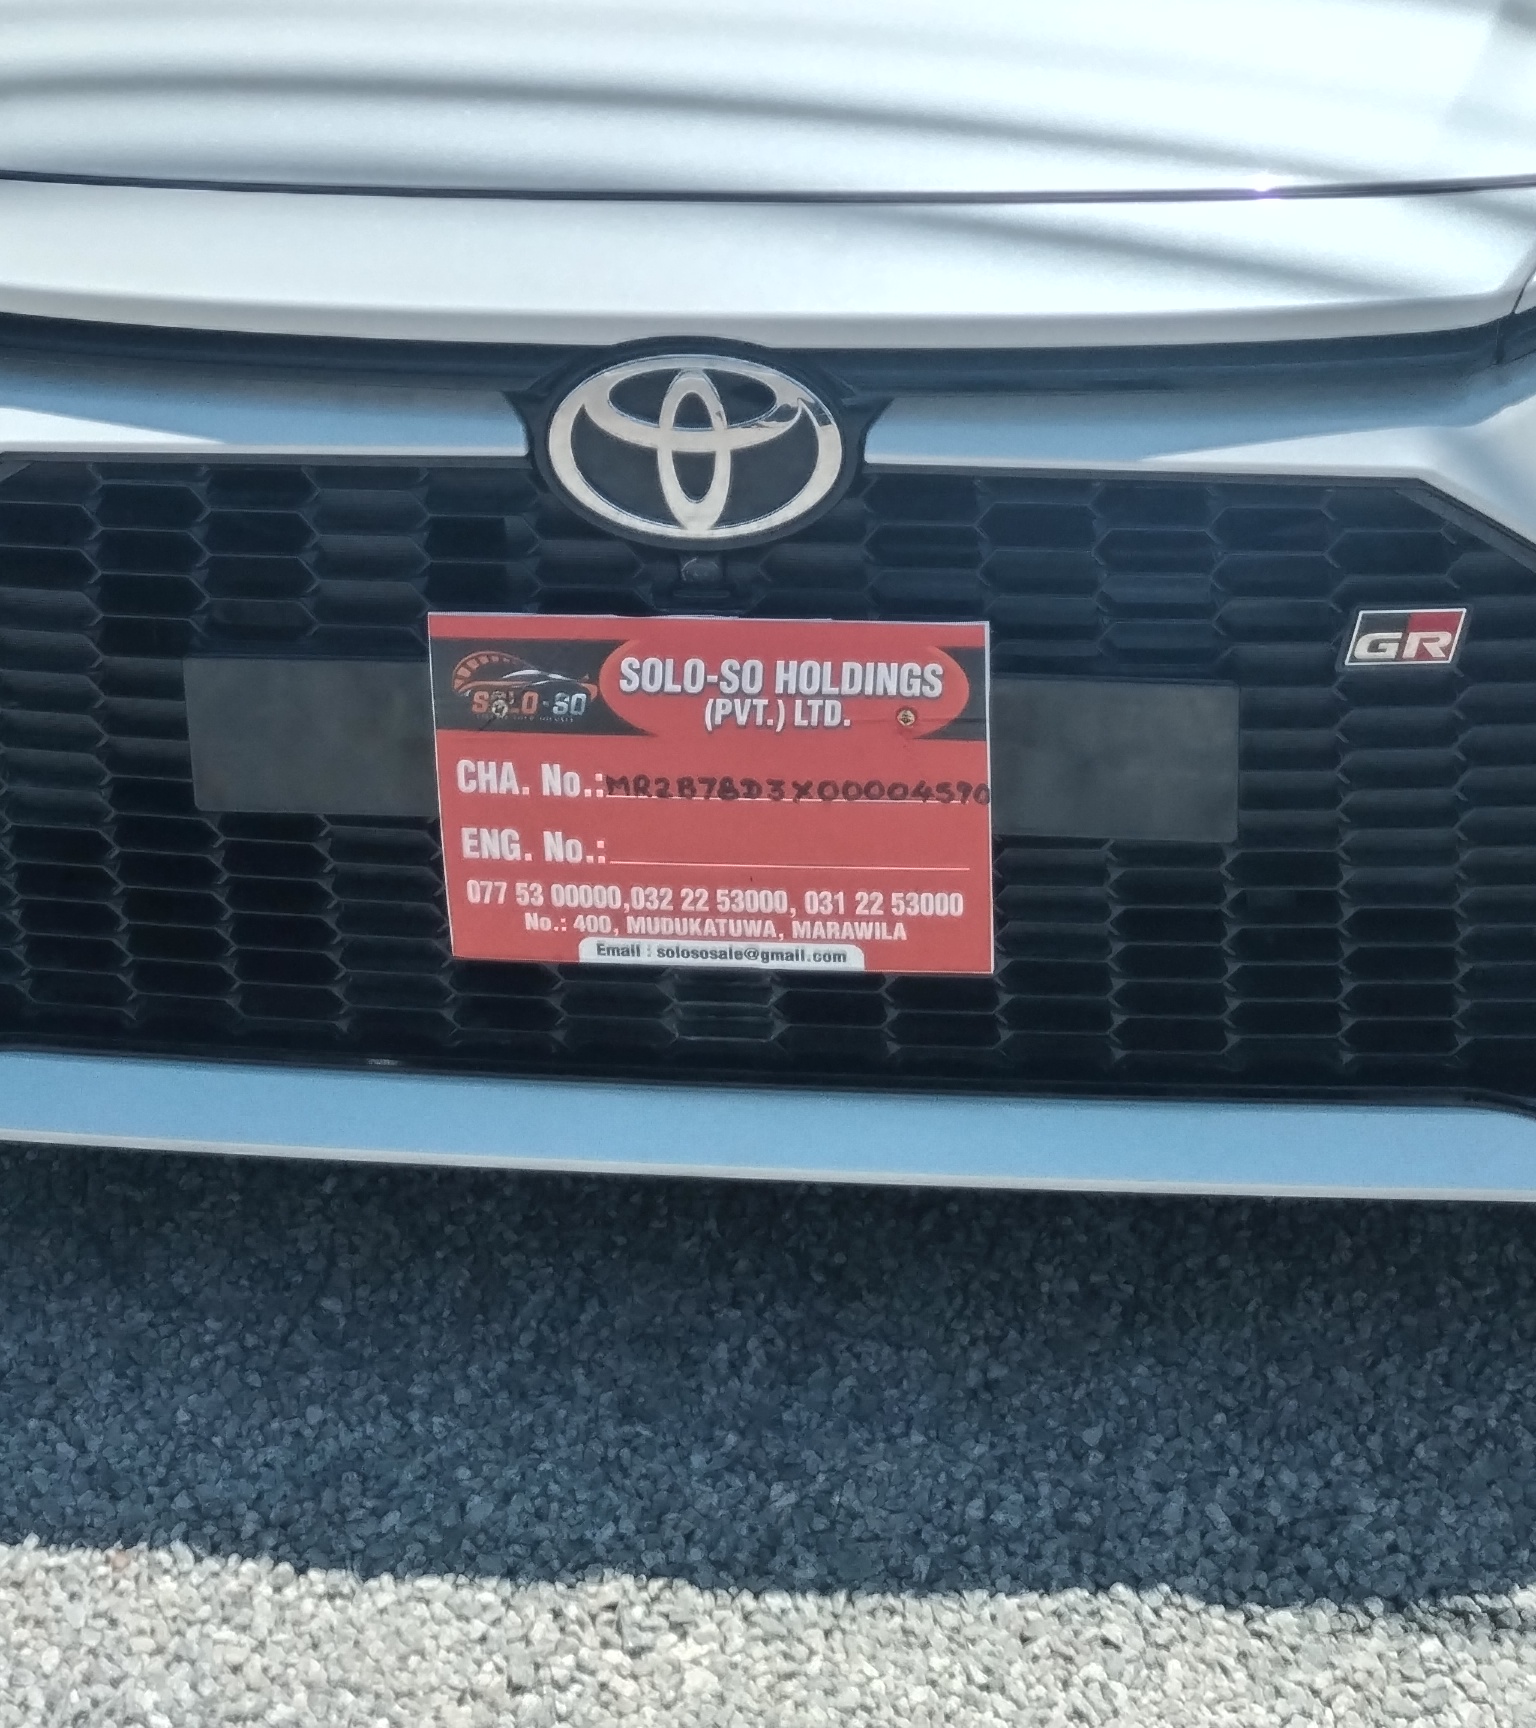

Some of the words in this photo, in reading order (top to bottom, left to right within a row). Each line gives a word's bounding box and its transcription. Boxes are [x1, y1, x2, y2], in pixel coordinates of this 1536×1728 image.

[1354, 631, 1452, 659] GR
[619, 656, 763, 695] SOLO-SO
[774, 659, 944, 699] HOLDINGS
[704, 697, 786, 733] (PVT.)
[794, 698, 851, 729] LTD.
[457, 759, 530, 795] CHA.
[541, 762, 604, 798] No.:
[461, 828, 533, 862] ENG.
[544, 830, 606, 865] No.:
[467, 879, 507, 905] 077
[515, 882, 544, 907] 53
[680, 887, 710, 912] 22
[716, 888, 797, 918] 53000,
[804, 890, 845, 915] 031
[855, 891, 884, 916] 22
[891, 892, 963, 917] 53000
[573, 914, 620, 937] 400,
[626, 916, 784, 941] MUDUKATUWA,
[792, 920, 907, 941] MARAWILA
[596, 943, 641, 959] Email
[656, 943, 847, 963] solososale@gmail.com
